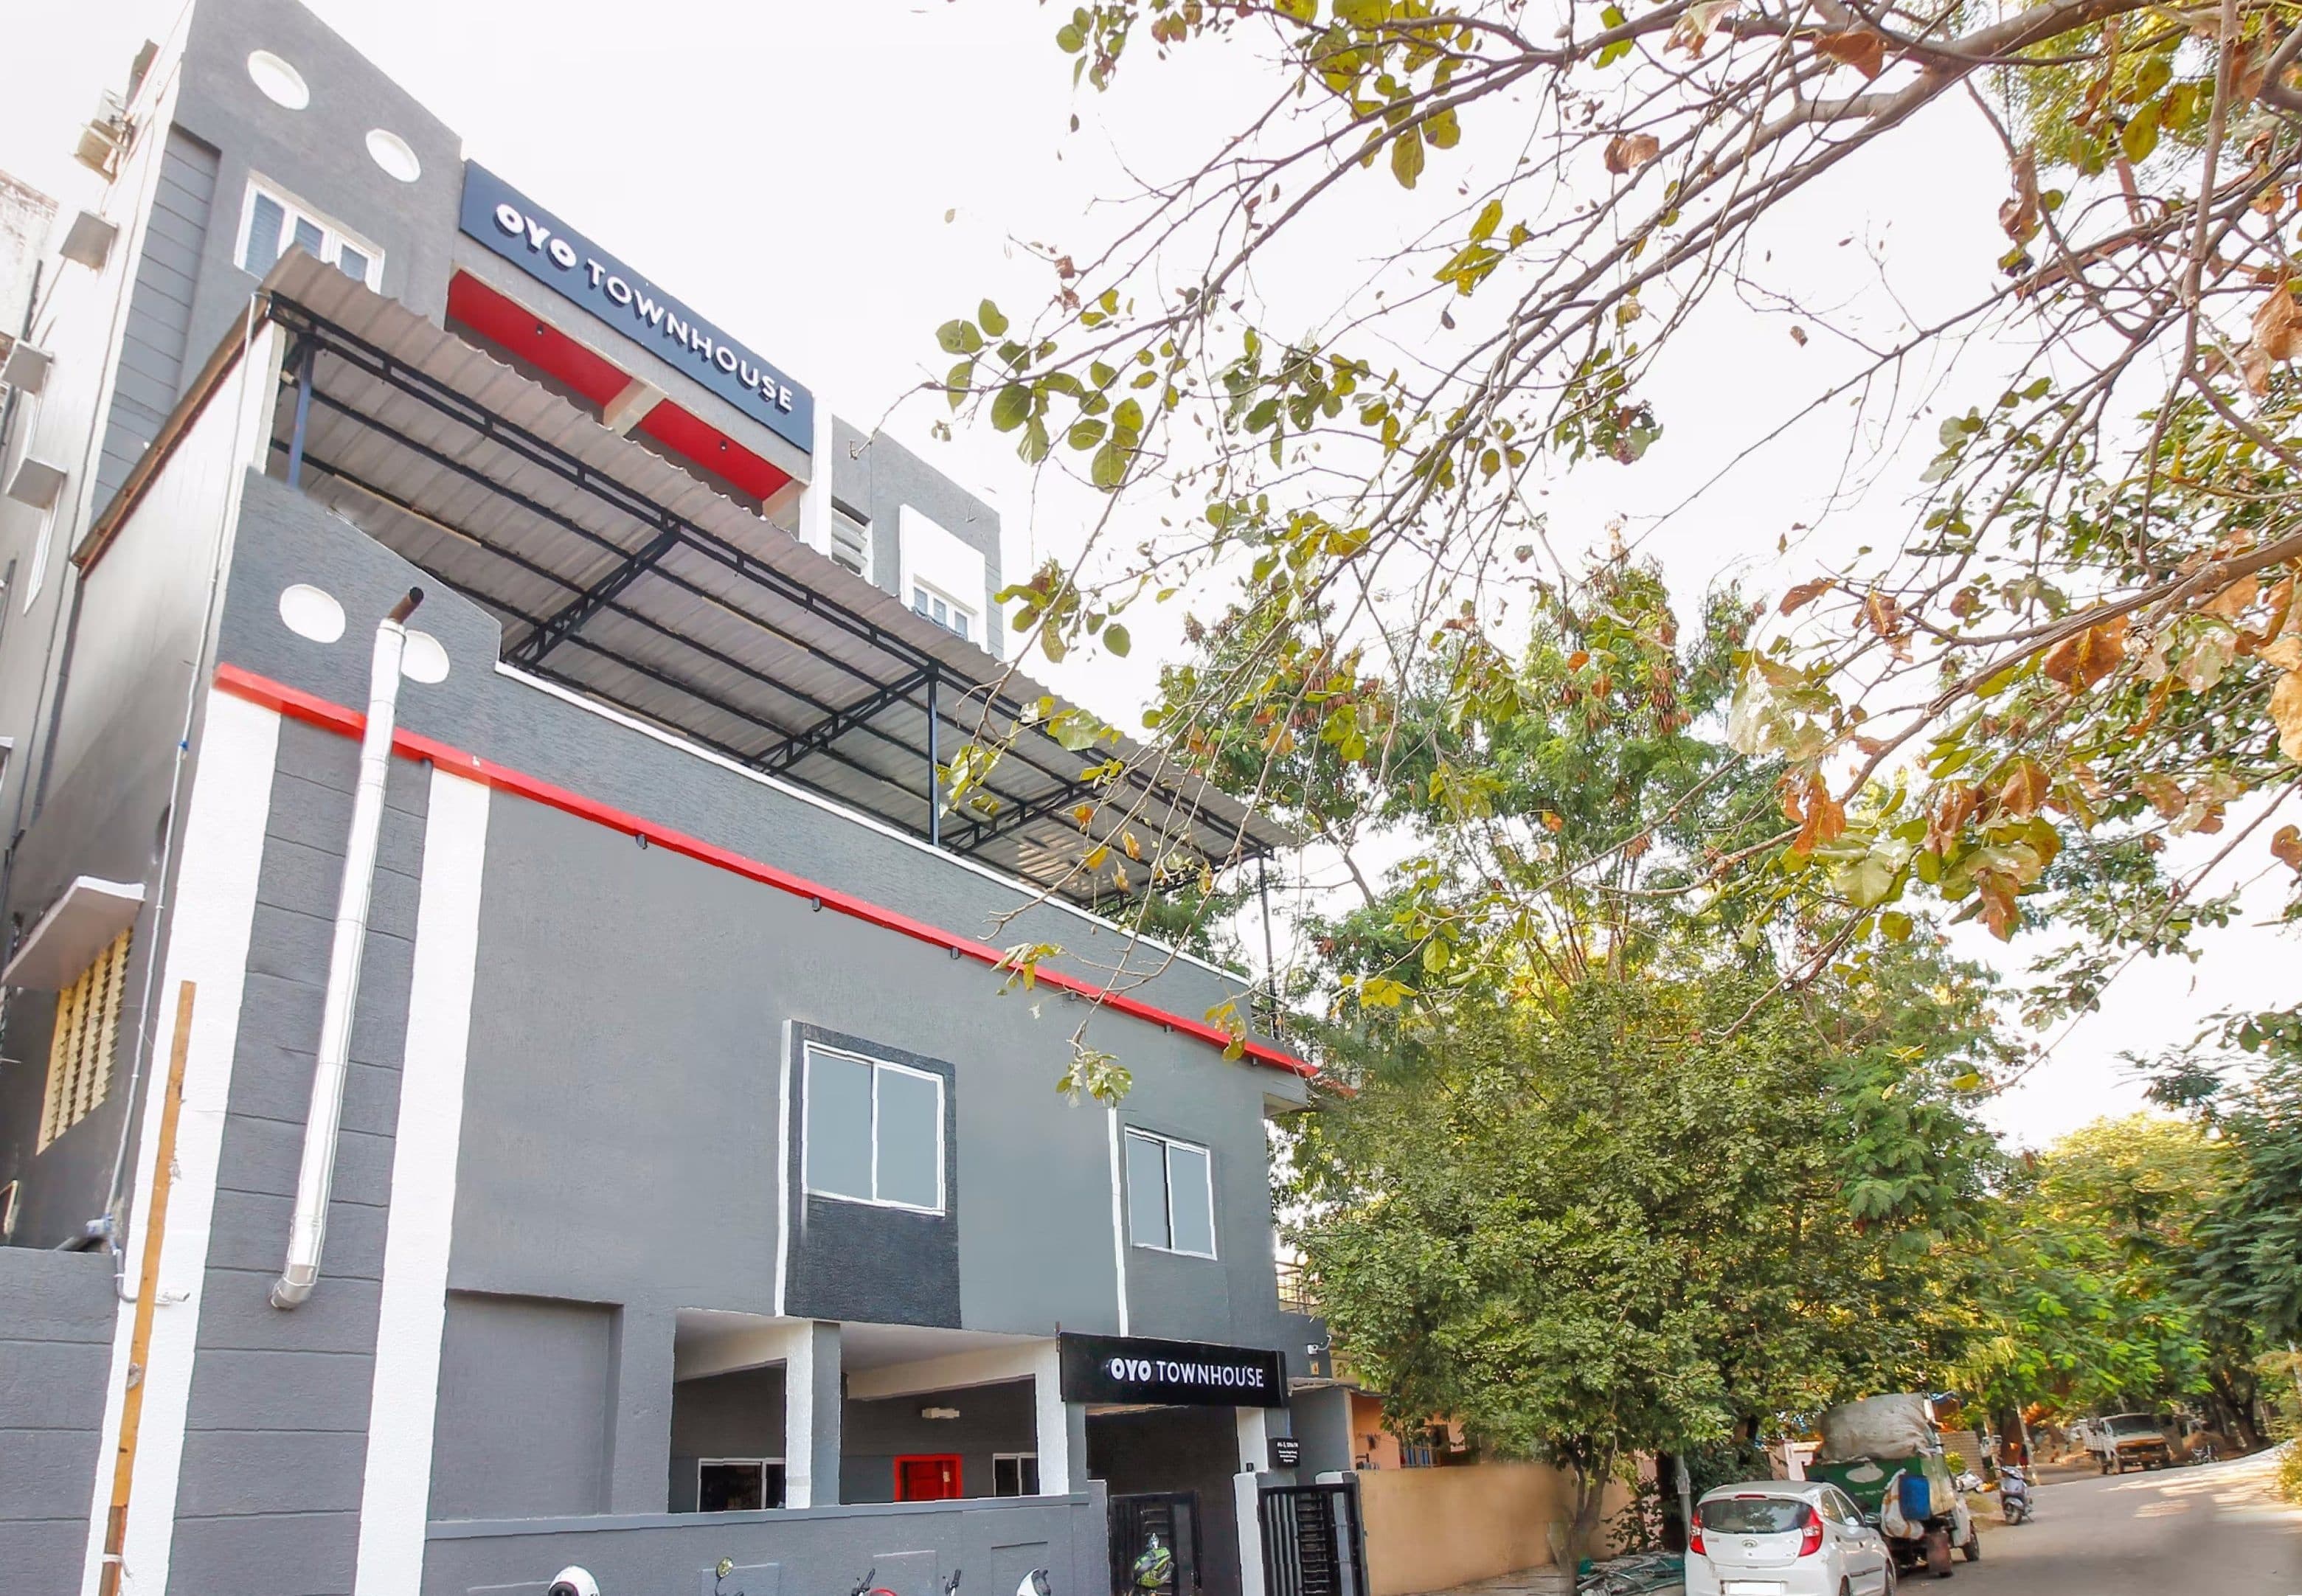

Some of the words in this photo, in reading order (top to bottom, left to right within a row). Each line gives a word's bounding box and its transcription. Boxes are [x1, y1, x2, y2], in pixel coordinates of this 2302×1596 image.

[496, 204, 577, 268] OYO
[588, 258, 793, 411] TOWNHOUSE
[1111, 1358, 1152, 1381] OYO
[1156, 1361, 1264, 1387] TOWNHOUSE
